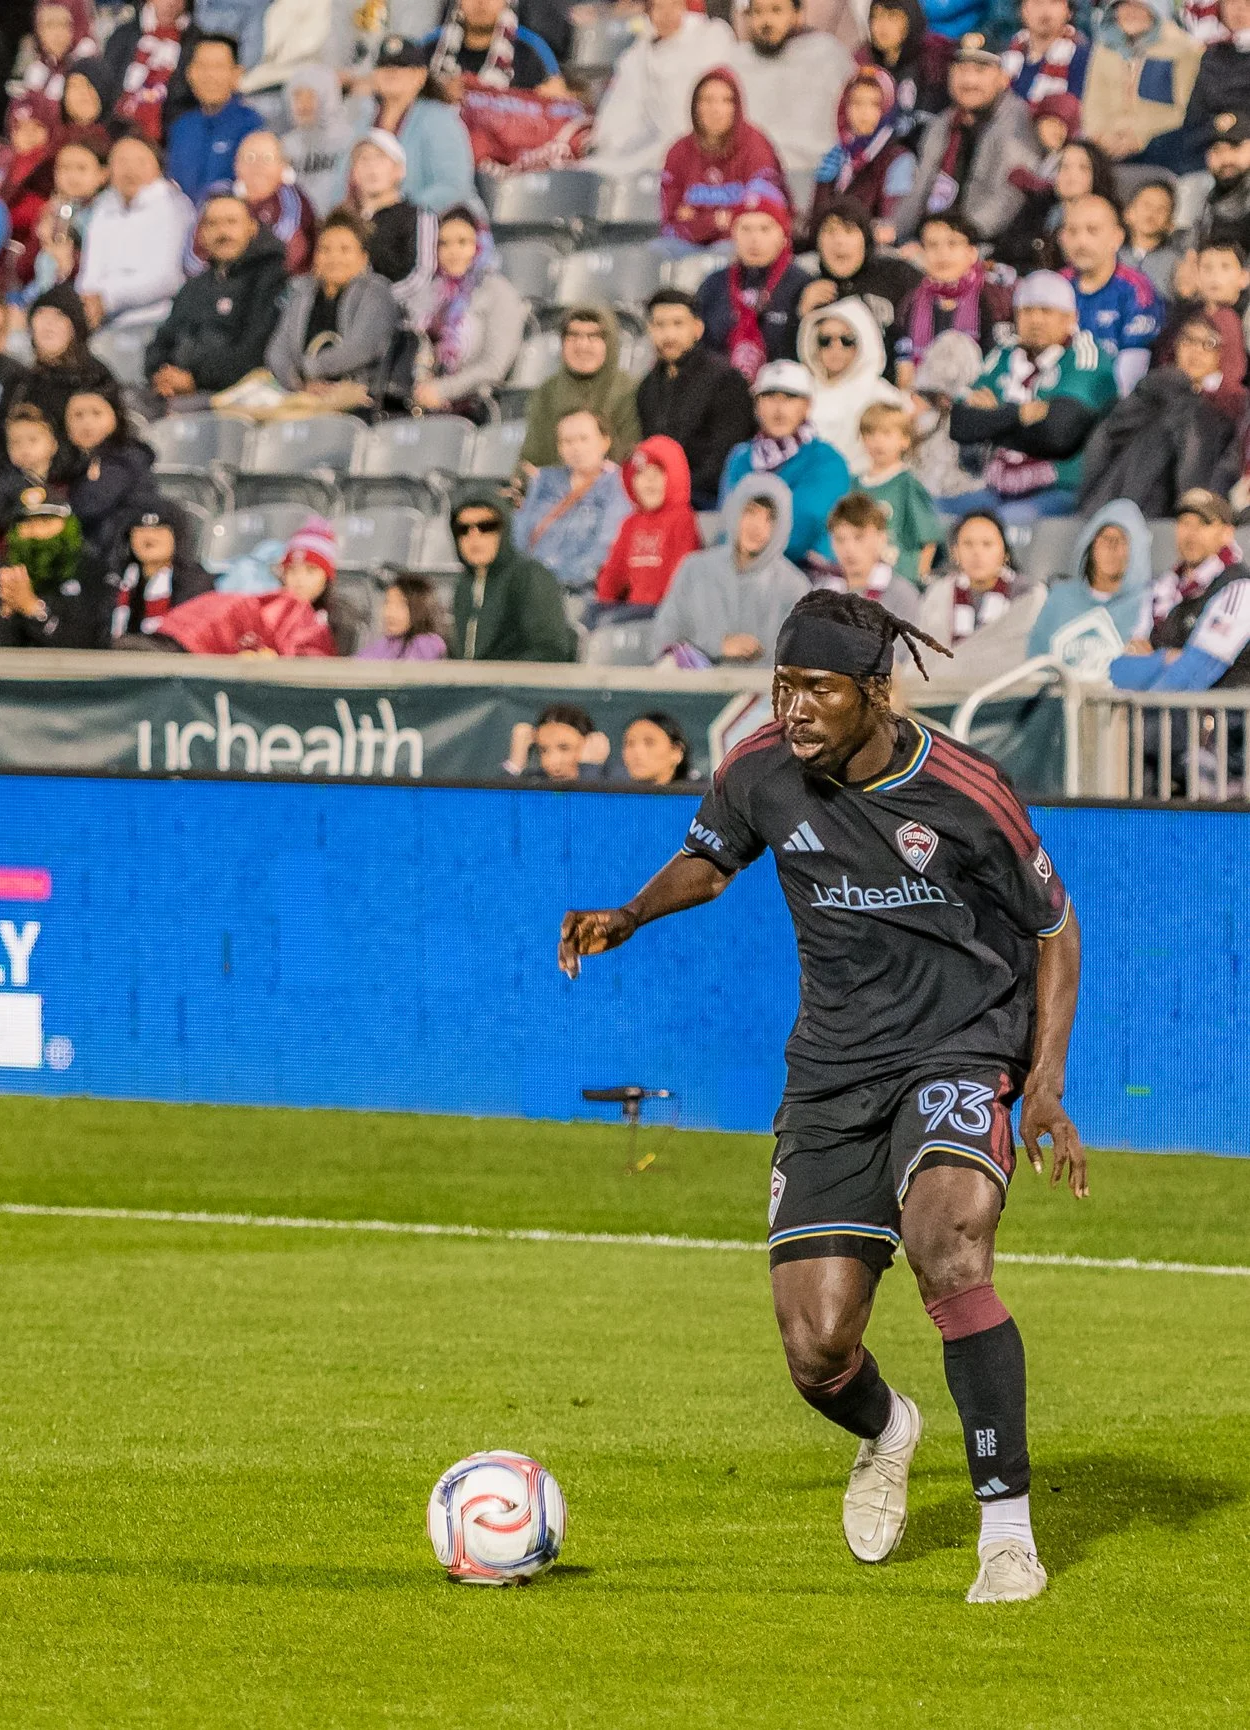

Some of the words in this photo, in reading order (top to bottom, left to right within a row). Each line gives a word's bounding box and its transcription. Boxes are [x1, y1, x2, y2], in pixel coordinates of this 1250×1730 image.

[903, 831, 931, 844] COLORADO
[812, 875, 948, 908] uchealth
[918, 1080, 994, 1136] 93
